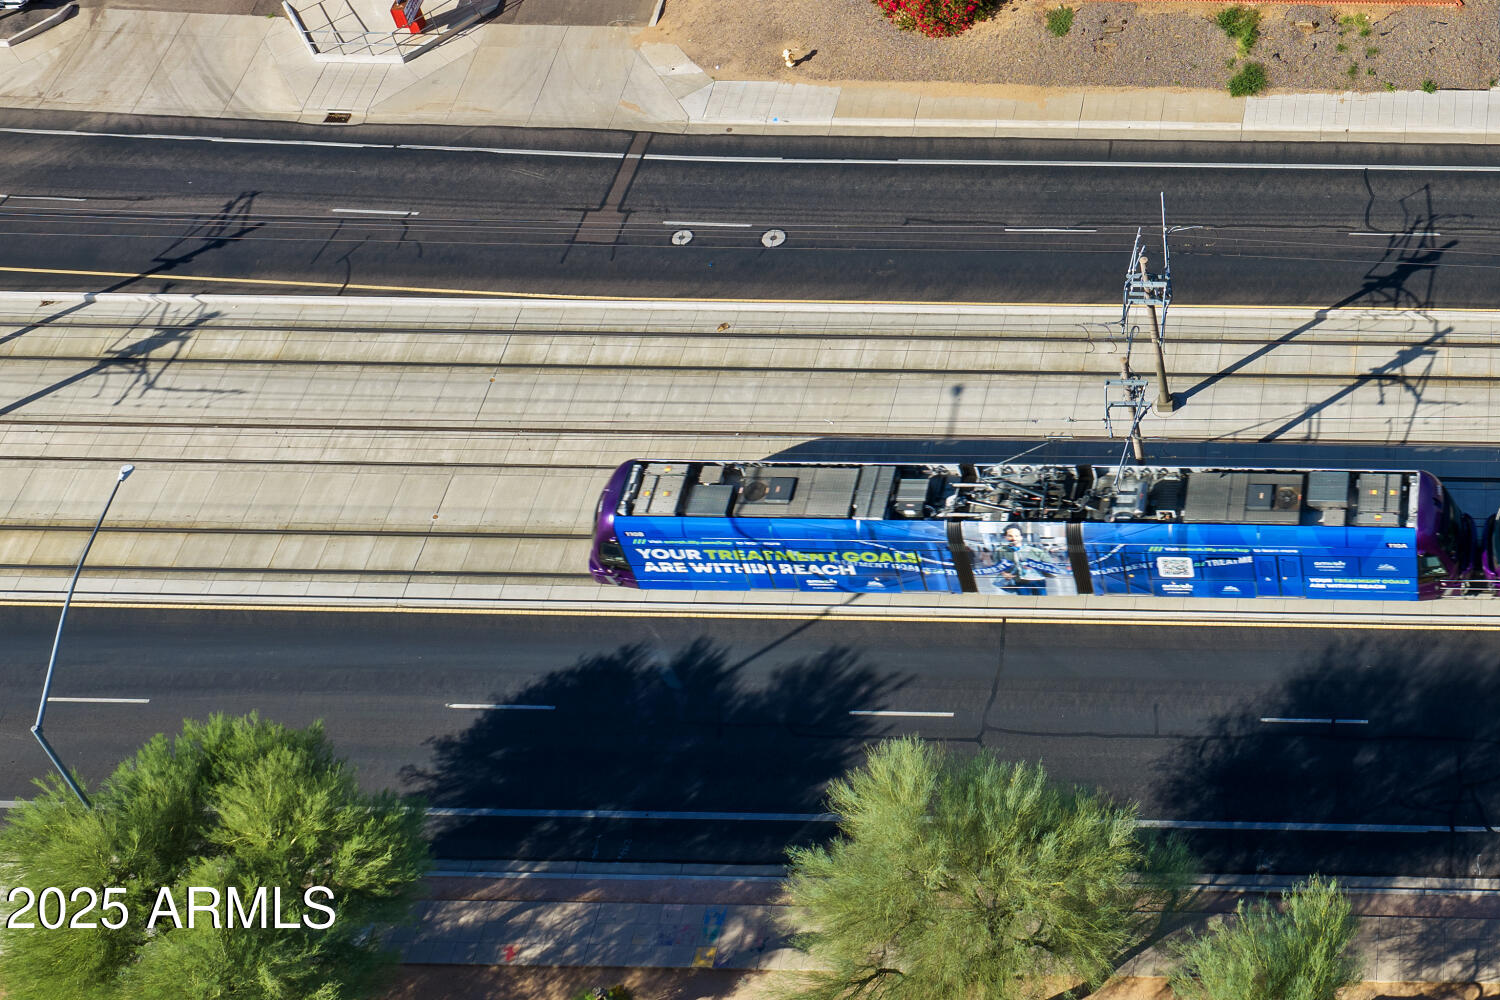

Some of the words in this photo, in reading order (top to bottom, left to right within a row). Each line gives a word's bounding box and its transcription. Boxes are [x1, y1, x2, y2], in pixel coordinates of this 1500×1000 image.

[635, 548, 702, 560] YOUR
[703, 549, 838, 563] TREATMENT
[842, 551, 922, 563] GOALS
[644, 561, 689, 573] ARE
[688, 562, 777, 574] WITHIN
[778, 563, 857, 576] REACH
